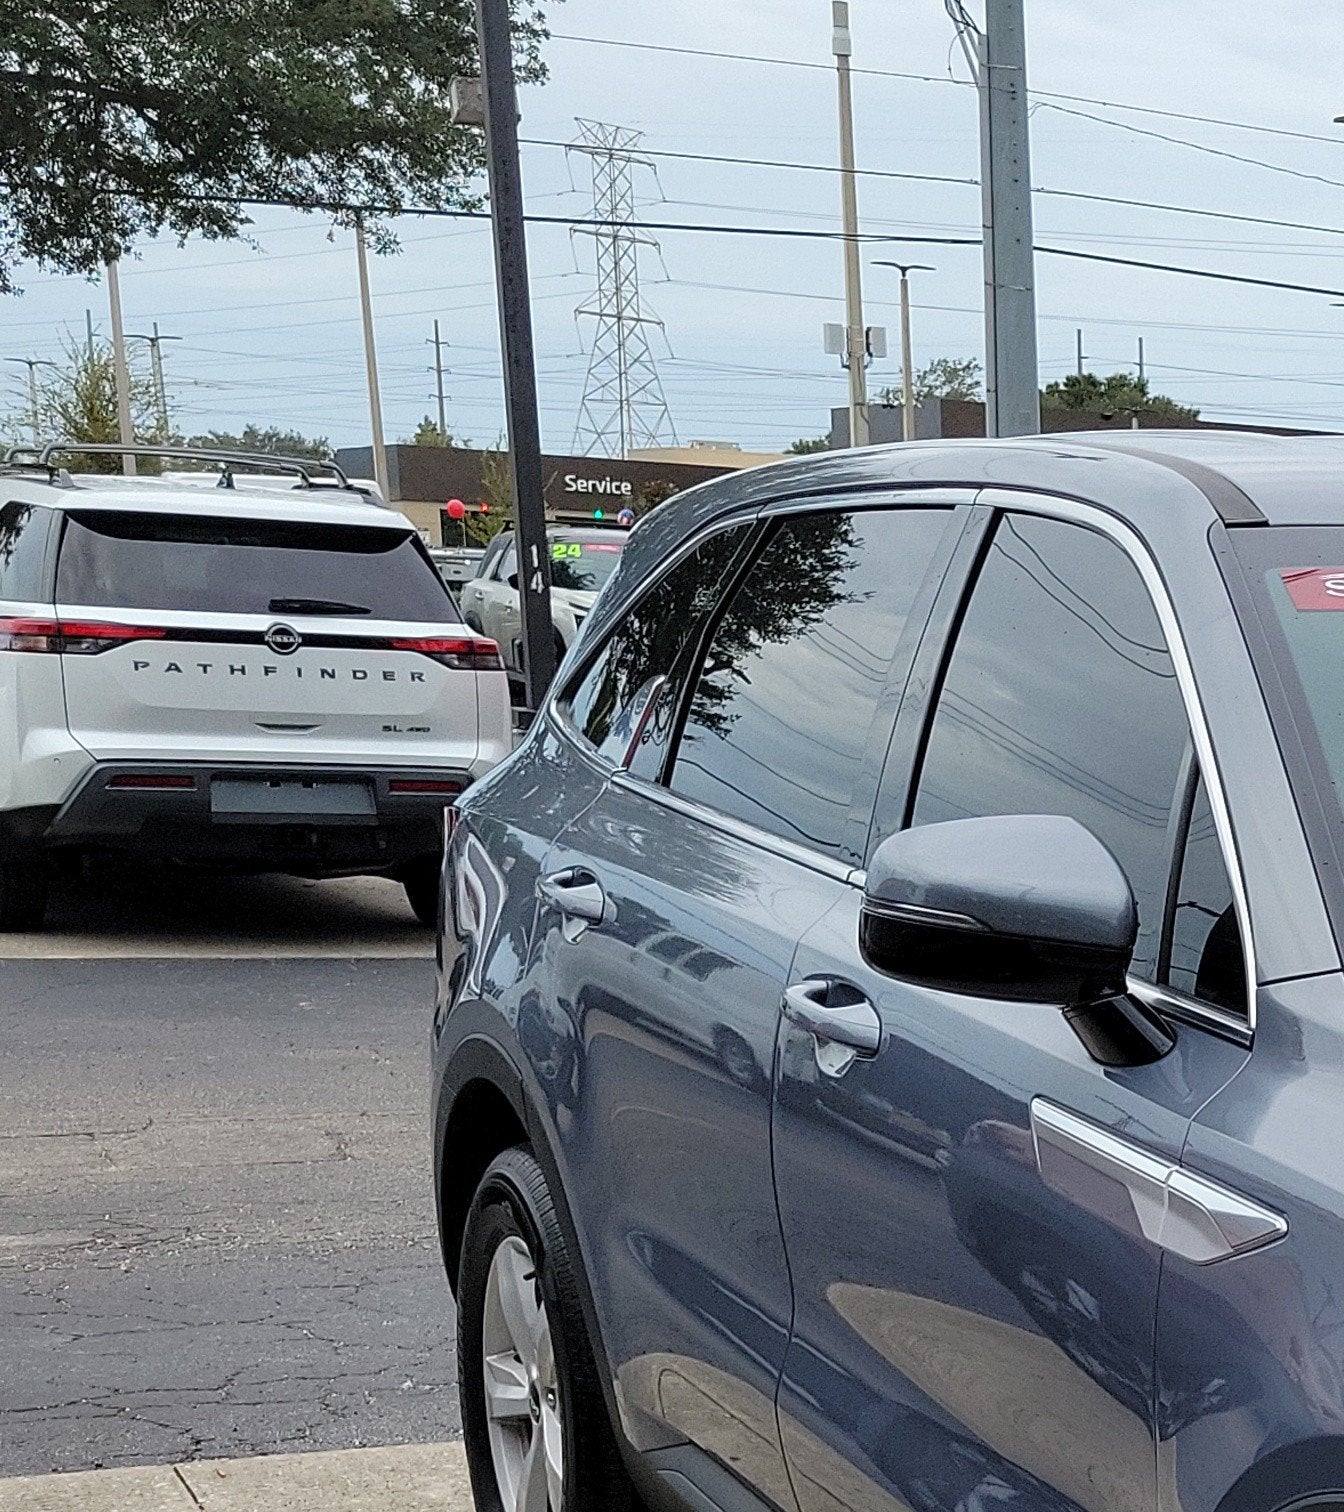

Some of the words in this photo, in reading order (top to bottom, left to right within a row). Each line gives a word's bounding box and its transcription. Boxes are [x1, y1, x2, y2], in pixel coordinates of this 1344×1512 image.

[564, 474, 632, 495] Service
[552, 543, 582, 559] 24
[132, 659, 426, 683] PATHFINDER
[381, 724, 403, 732] SL
